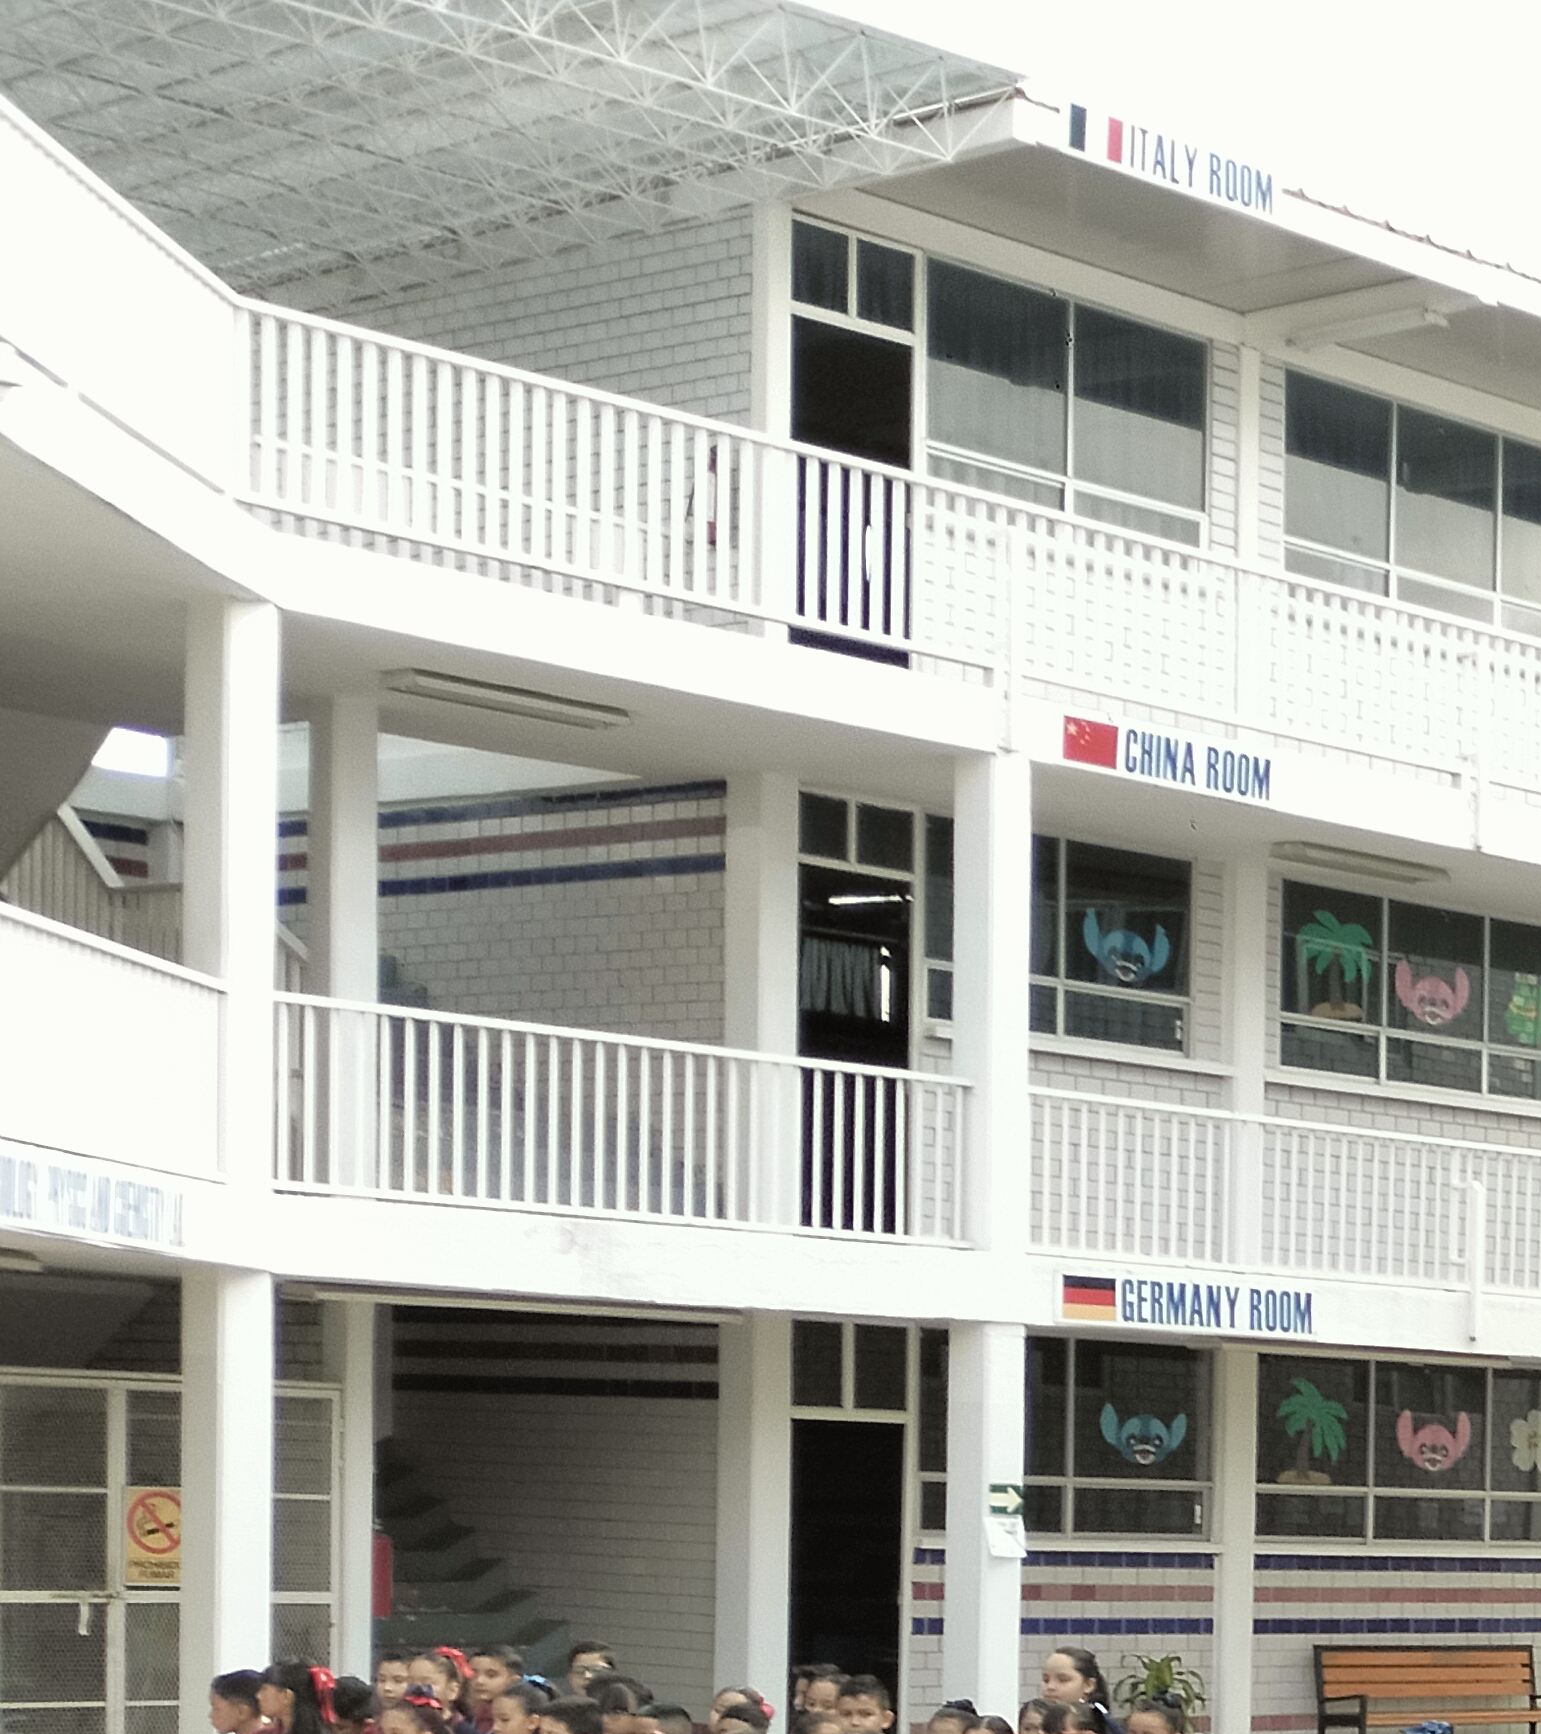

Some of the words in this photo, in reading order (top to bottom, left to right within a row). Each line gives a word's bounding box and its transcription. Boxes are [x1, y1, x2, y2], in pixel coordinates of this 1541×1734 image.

[1130, 124, 1198, 188] ITALY
[1209, 152, 1273, 215] ROOM
[1124, 729, 1196, 786] CHINA
[1206, 746, 1271, 801] ROOM
[1121, 1279, 1240, 1328] GERMANY
[1249, 1288, 1312, 1334] ROOM
